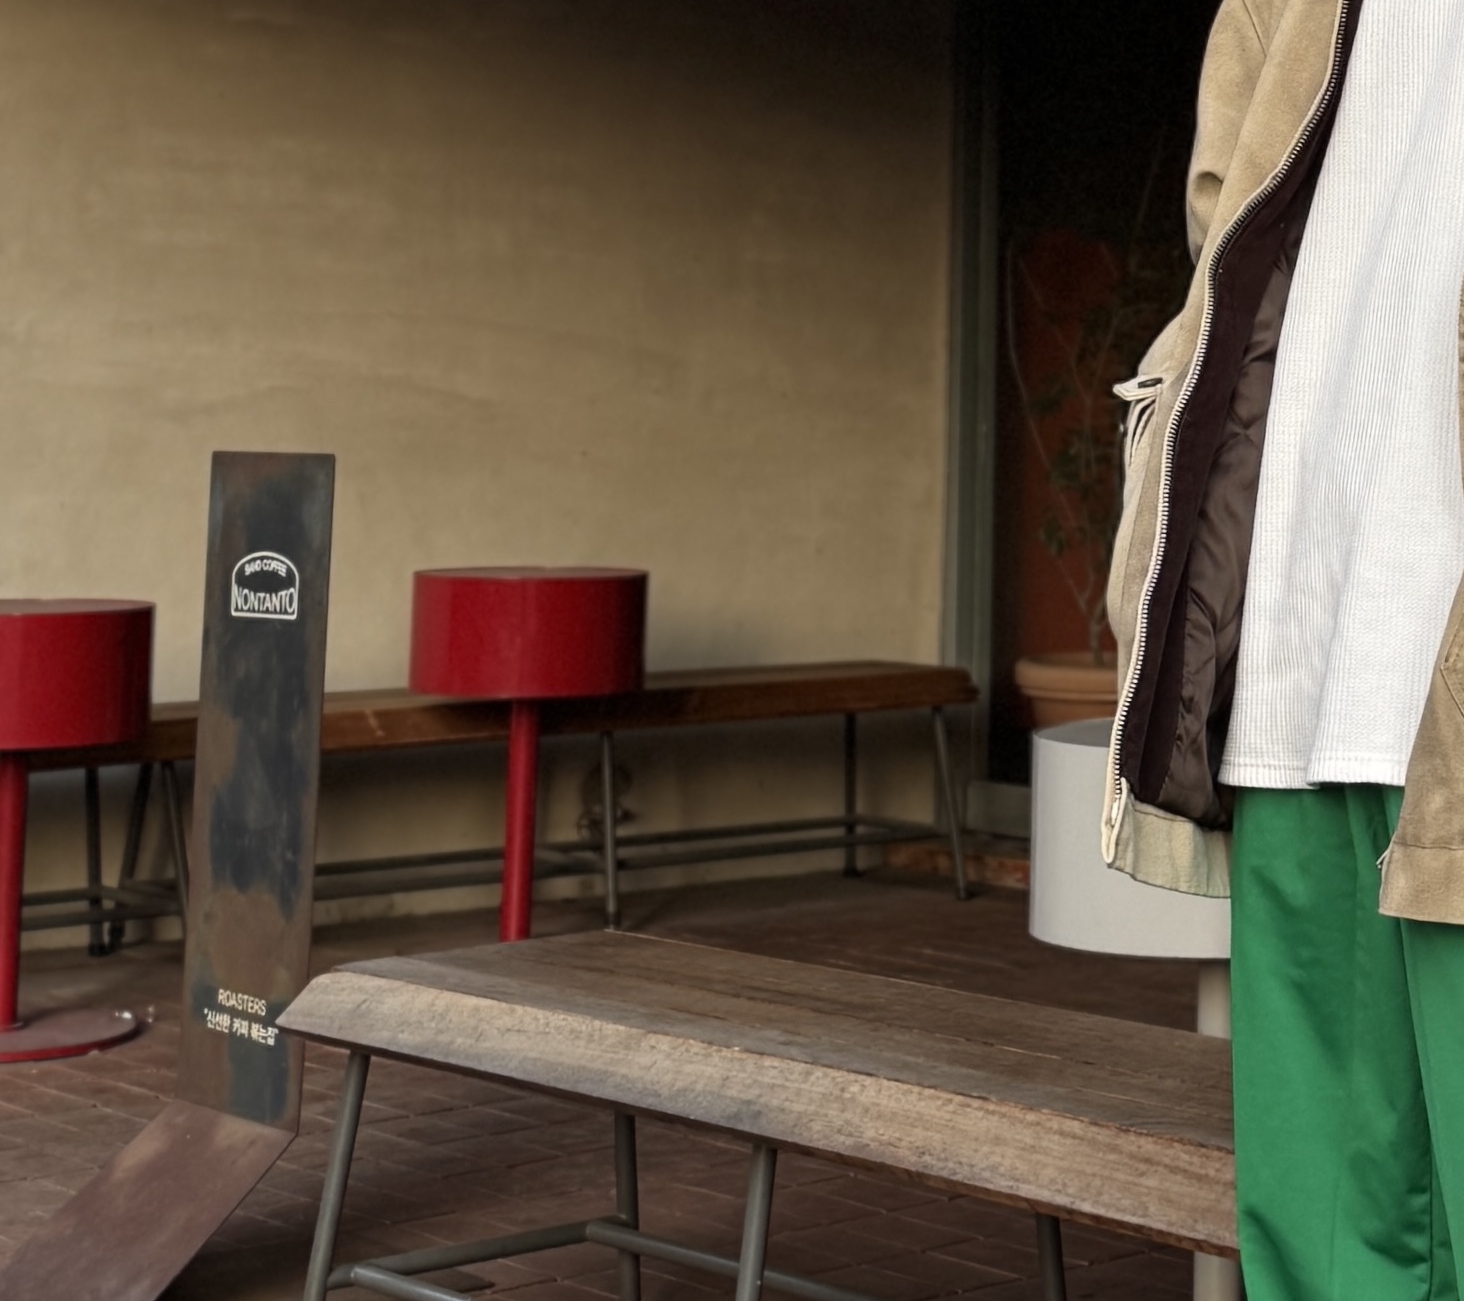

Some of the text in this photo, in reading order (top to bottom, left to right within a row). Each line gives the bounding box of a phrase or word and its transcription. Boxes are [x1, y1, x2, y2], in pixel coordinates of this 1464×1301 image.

[233, 583, 296, 613] NONTANTO
[218, 988, 267, 1016] ROASTERS
[232, 1017, 249, 1039] 커피
